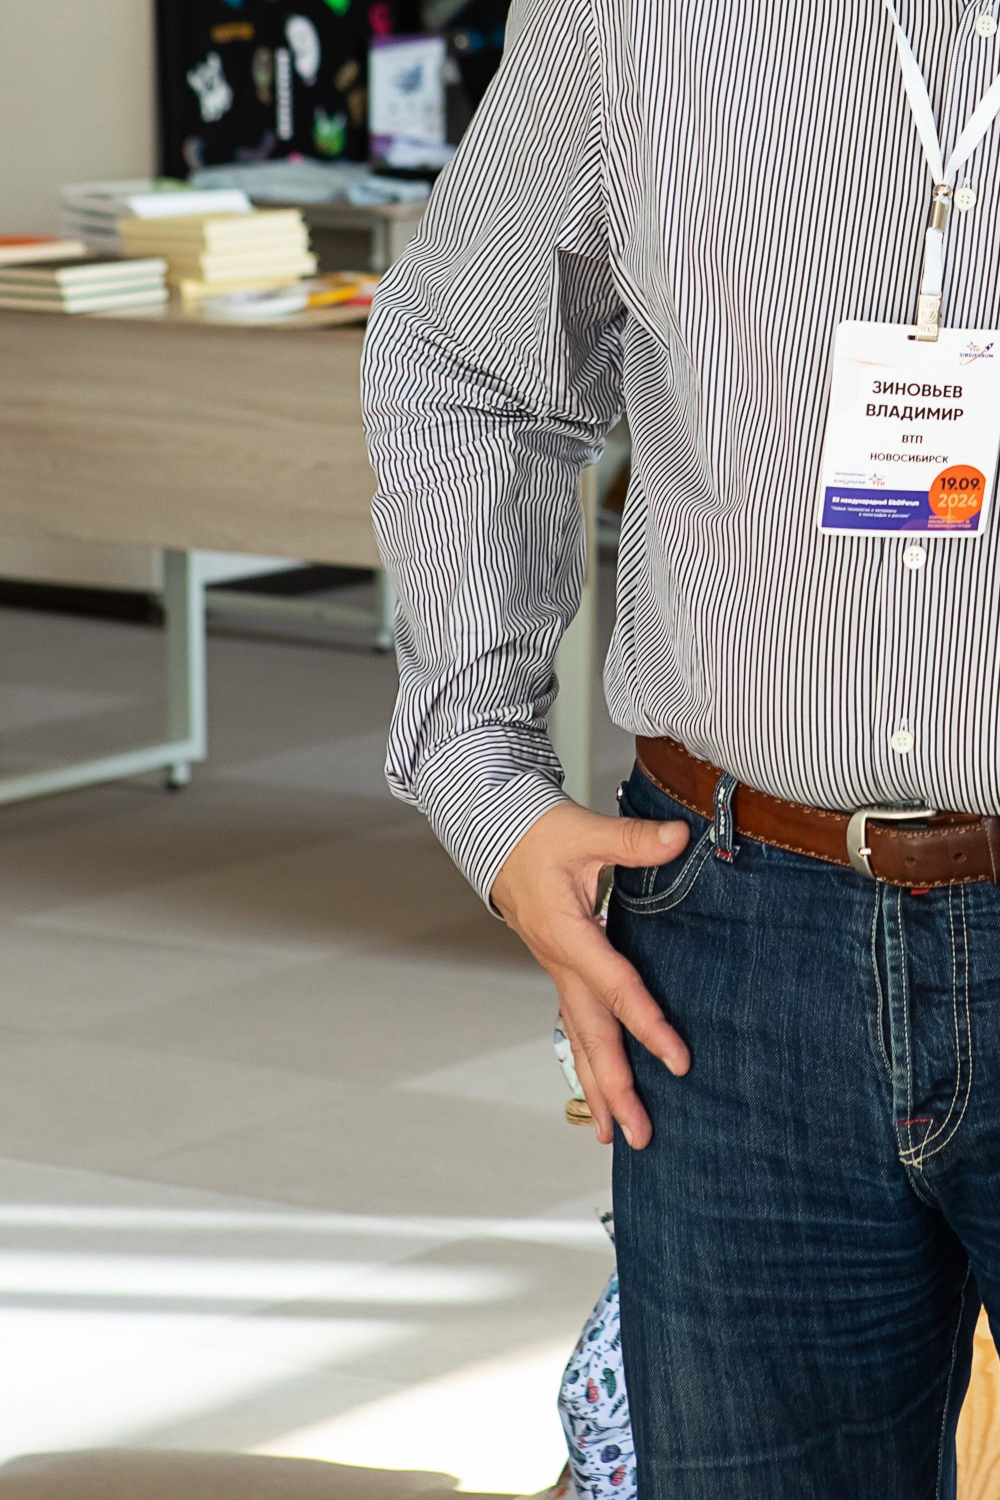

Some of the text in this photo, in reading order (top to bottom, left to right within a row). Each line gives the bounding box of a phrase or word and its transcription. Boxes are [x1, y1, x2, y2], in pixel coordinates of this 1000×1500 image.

[872, 380, 963, 399] ЗИНОВЬЕВ
[866, 403, 964, 421] ВЛАДИМИР
[901, 434, 923, 444] ВТП
[870, 452, 949, 464] НОВОСИБИРСК
[940, 477, 981, 491] 19.09.
[937, 493, 978, 508] 2024
